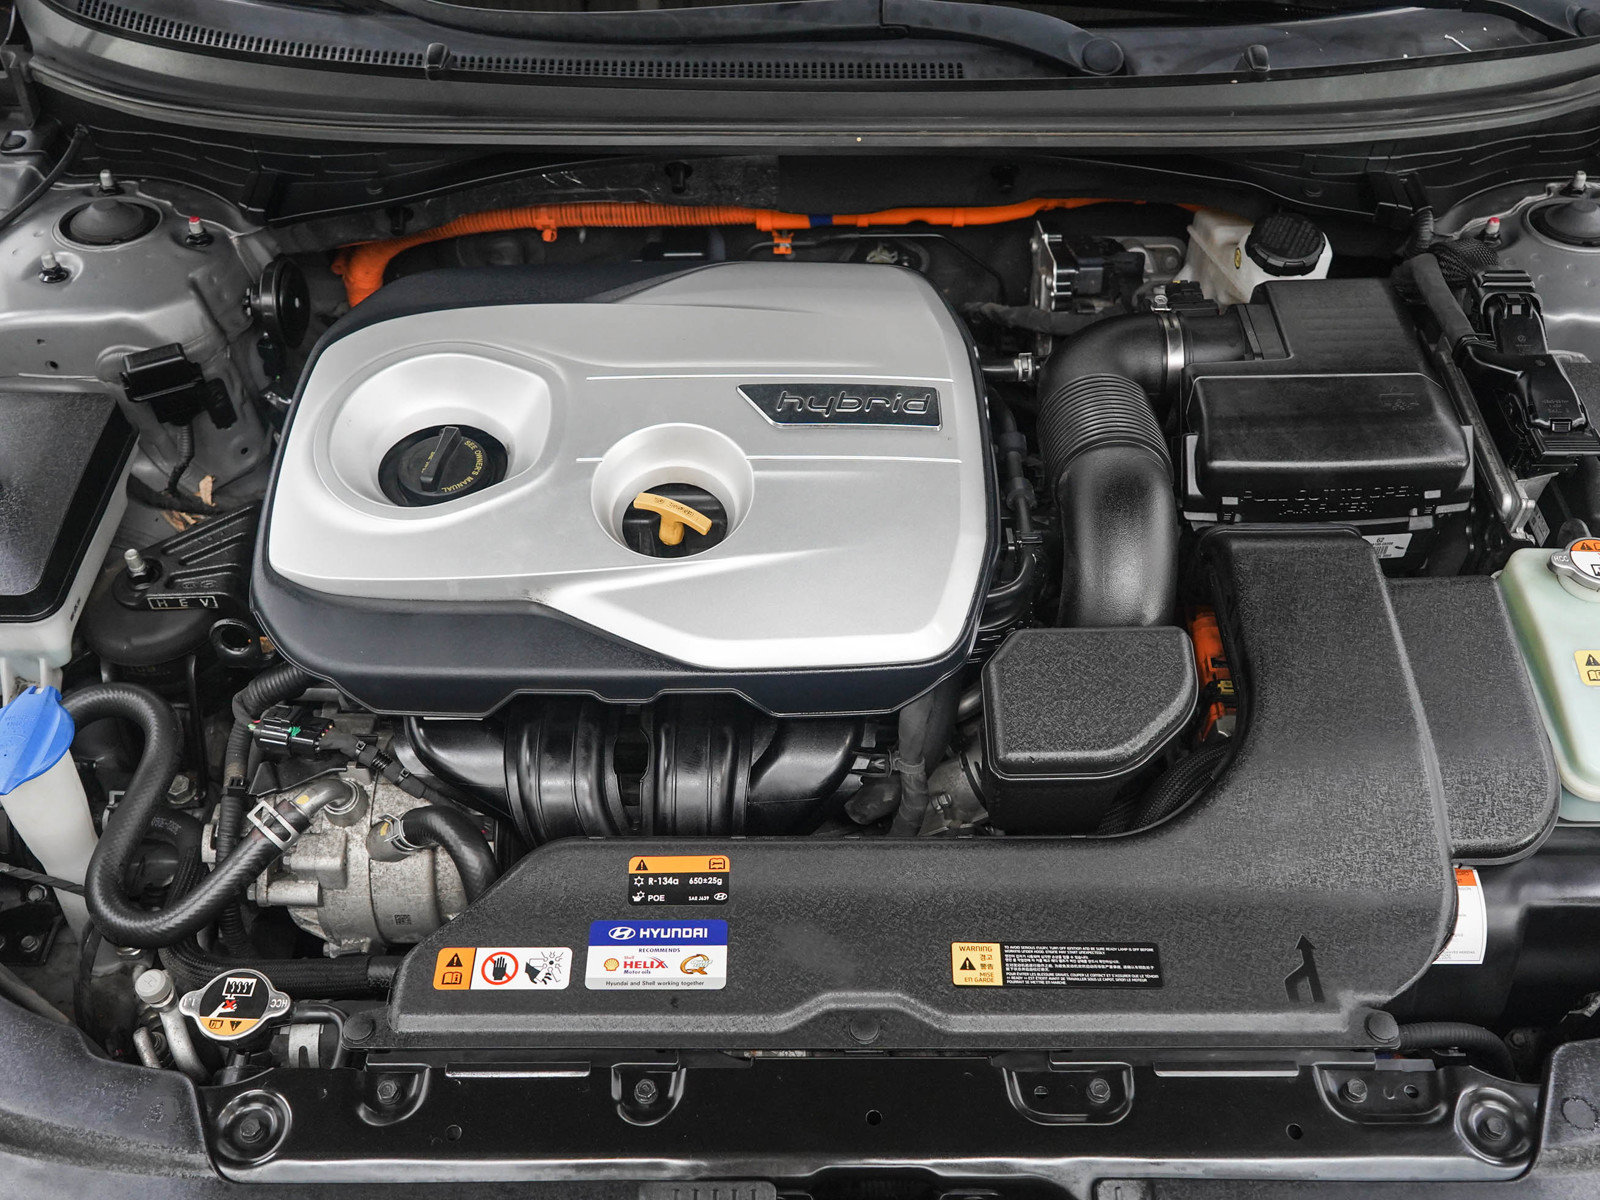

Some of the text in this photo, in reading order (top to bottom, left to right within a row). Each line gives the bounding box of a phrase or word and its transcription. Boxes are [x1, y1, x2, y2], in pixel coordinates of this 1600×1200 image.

[776, 390, 931, 418] hybrid
[441, 440, 483, 493] SEE OWNER'S MANUAL
[648, 877, 722, 886] R-134a 650±25g
[640, 928, 708, 938] HYUNDAI
[624, 957, 666, 969] HELIX
[269, 998, 288, 1009] HCC
